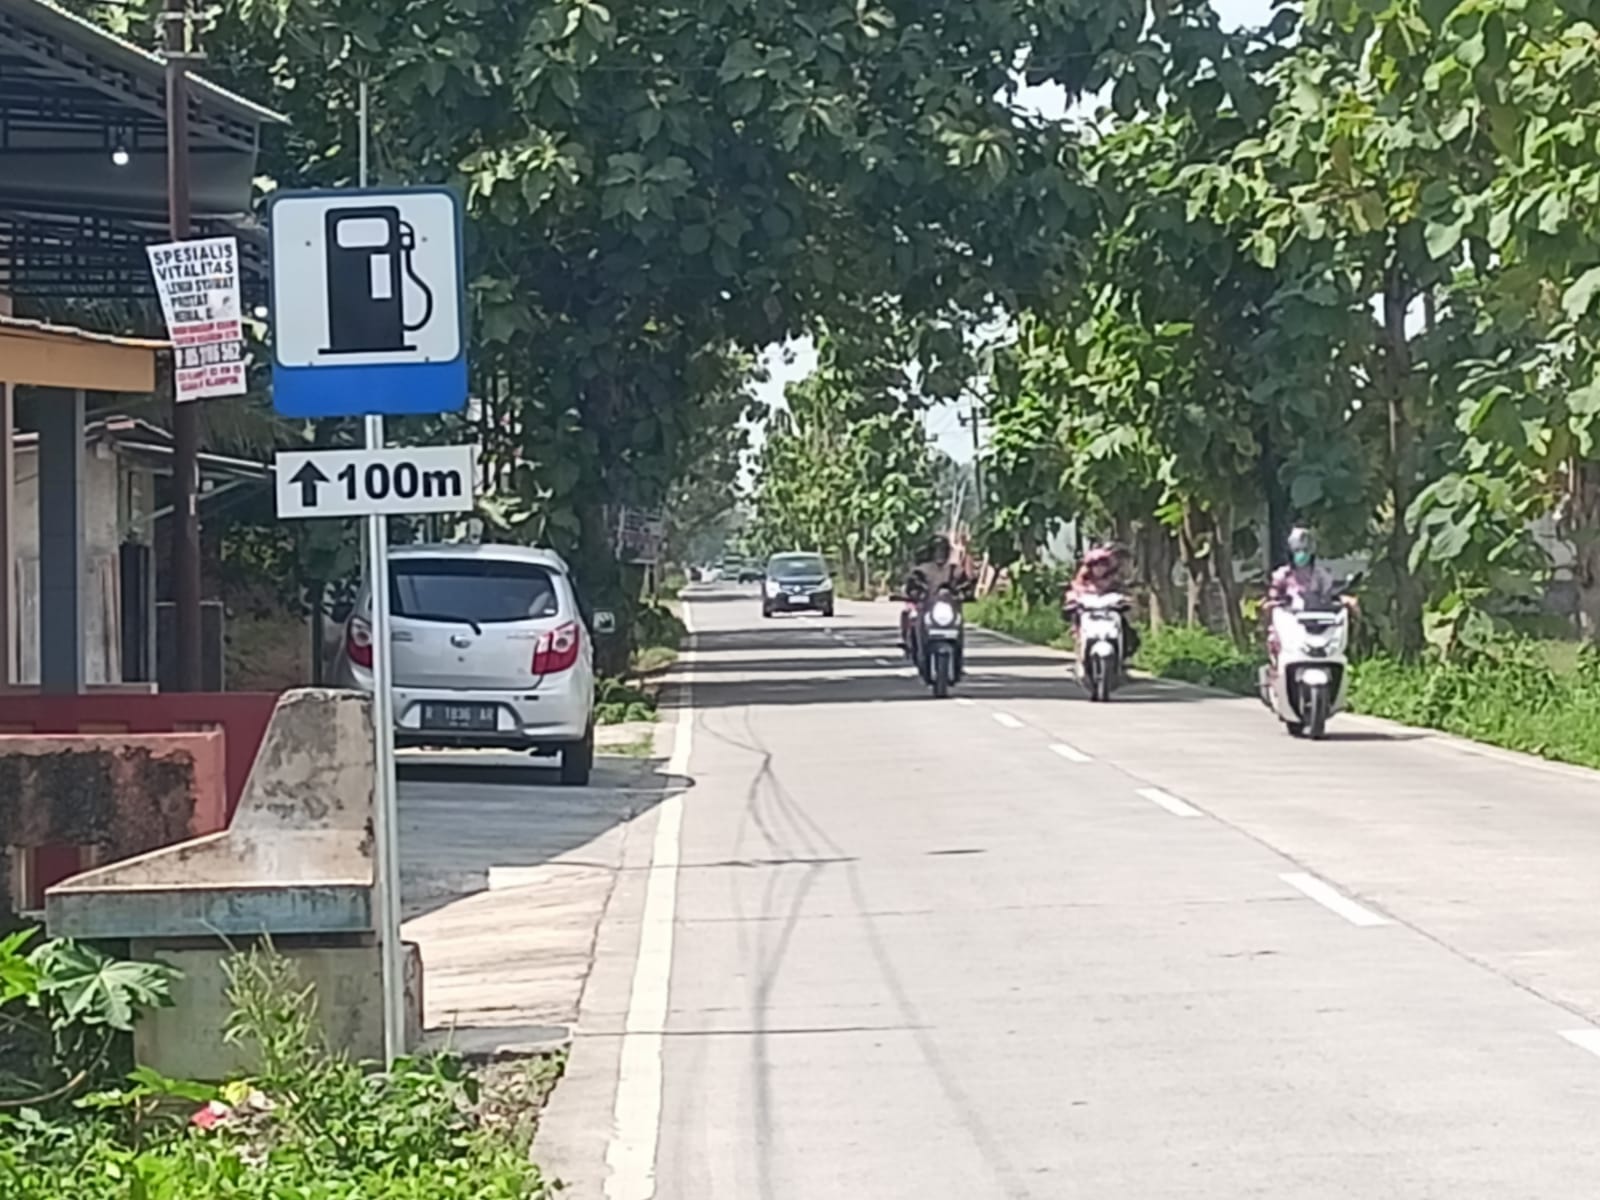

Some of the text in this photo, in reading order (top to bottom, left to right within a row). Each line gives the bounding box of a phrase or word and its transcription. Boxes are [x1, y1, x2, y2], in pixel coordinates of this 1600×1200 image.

[153, 244, 233, 266] SPESIALIS
[156, 260, 233, 281] VITALITAS
[338, 461, 462, 501] 100m
